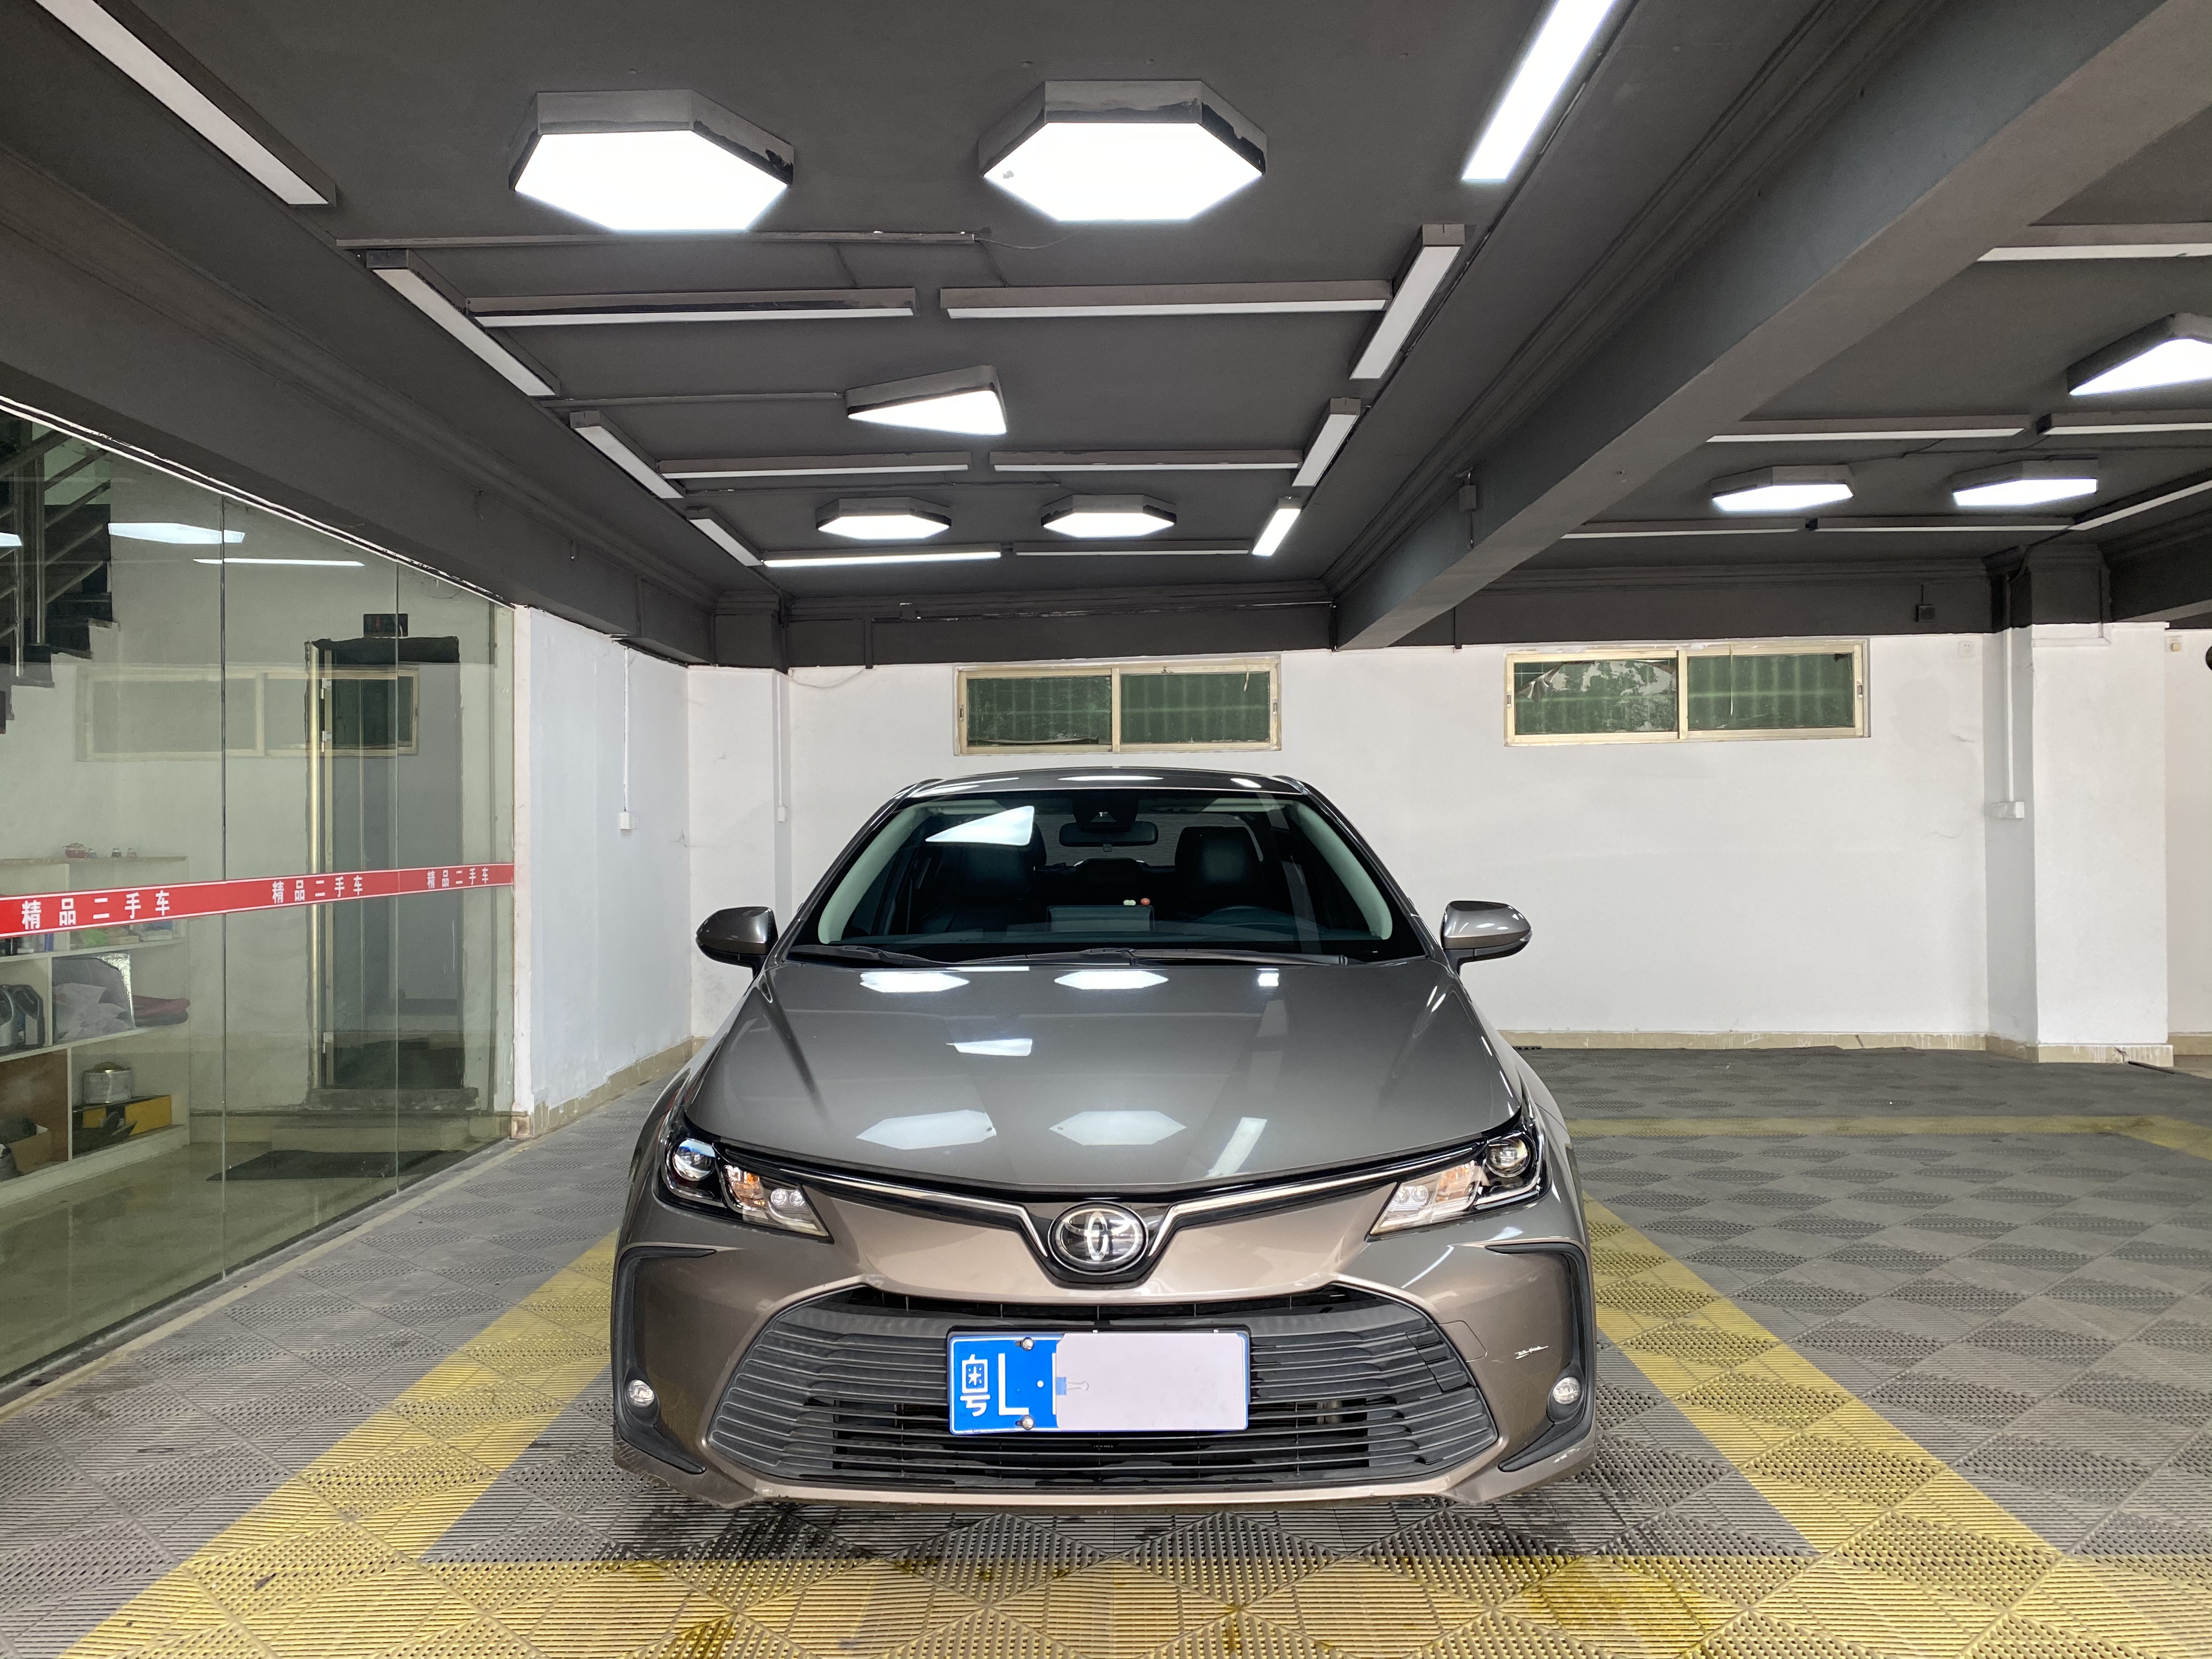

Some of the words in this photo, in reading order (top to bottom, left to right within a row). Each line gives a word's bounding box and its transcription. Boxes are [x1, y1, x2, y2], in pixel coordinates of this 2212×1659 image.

[272, 875, 363, 904] 精品二手车
[427, 867, 489, 889] 精品二手车
[21, 890, 170, 930] 精品二手车
